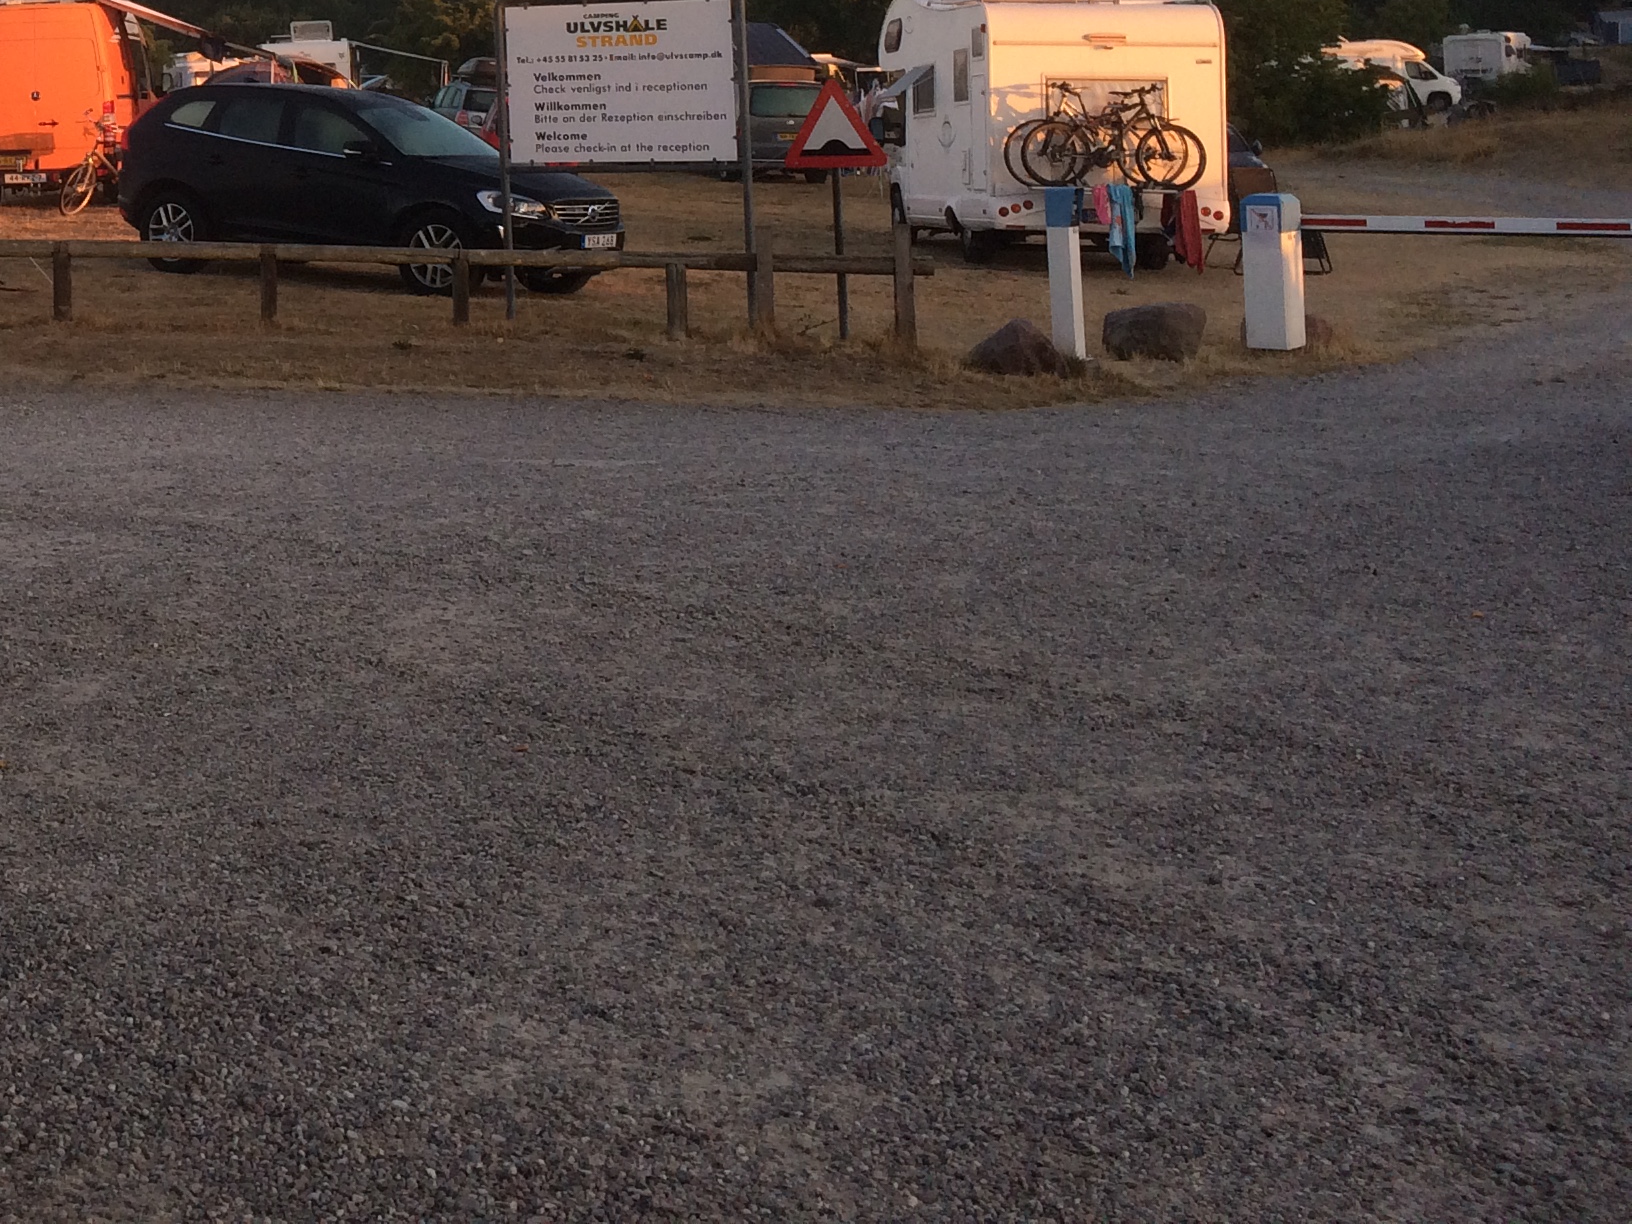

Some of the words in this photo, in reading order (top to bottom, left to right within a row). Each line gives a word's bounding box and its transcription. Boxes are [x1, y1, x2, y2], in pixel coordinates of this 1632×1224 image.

[576, 33, 658, 48] STRAND
[638, 50, 723, 62] info@ulvscamp.dk
[533, 72, 602, 82] Velkommen
[533, 84, 566, 94] Check
[570, 83, 611, 95] venligst
[615, 82, 632, 92] ind
[642, 81, 708, 93] receptionen
[534, 101, 607, 111] Willkommen
[534, 114, 558, 124] Bitte
[579, 112, 597, 123] der
[601, 112, 654, 124] Rezeption
[657, 110, 727, 121] einschreiben
[535, 131, 588, 141] Welcome
[535, 143, 570, 153] Please
[574, 142, 617, 153] check-in
[620, 143, 632, 152] at
[636, 142, 654, 152] the
[657, 141, 710, 153] reception
